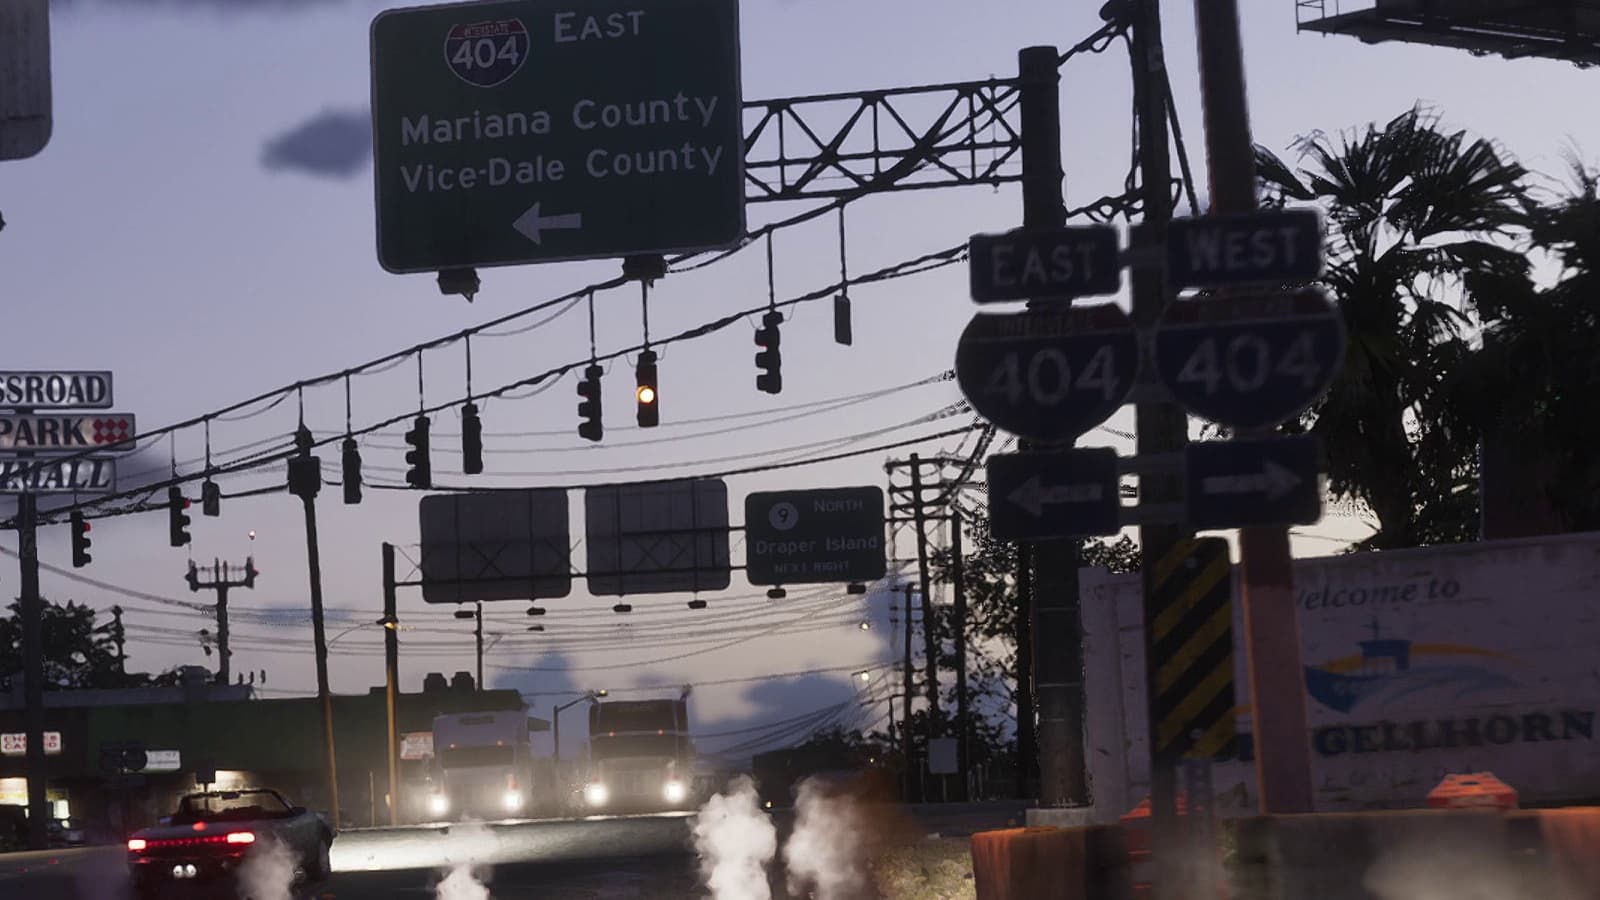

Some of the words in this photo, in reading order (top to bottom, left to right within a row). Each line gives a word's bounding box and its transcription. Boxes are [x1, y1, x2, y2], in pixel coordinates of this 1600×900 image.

[554, 10, 646, 43] EAST
[450, 35, 520, 71] 404
[401, 110, 551, 146] Mariana
[572, 89, 719, 131] County
[399, 155, 565, 193] Vice-Dale
[585, 139, 724, 179] County
[989, 241, 1097, 288] EAST
[1186, 226, 1300, 272] WEST
[984, 343, 1121, 408] 404
[1176, 329, 1322, 394] 404
[0, 375, 106, 403] SROAD
[755, 539, 817, 557] Draper
[825, 535, 879, 552] Island
[1297, 582, 1417, 610] elcome
[1427, 577, 1461, 600] to
